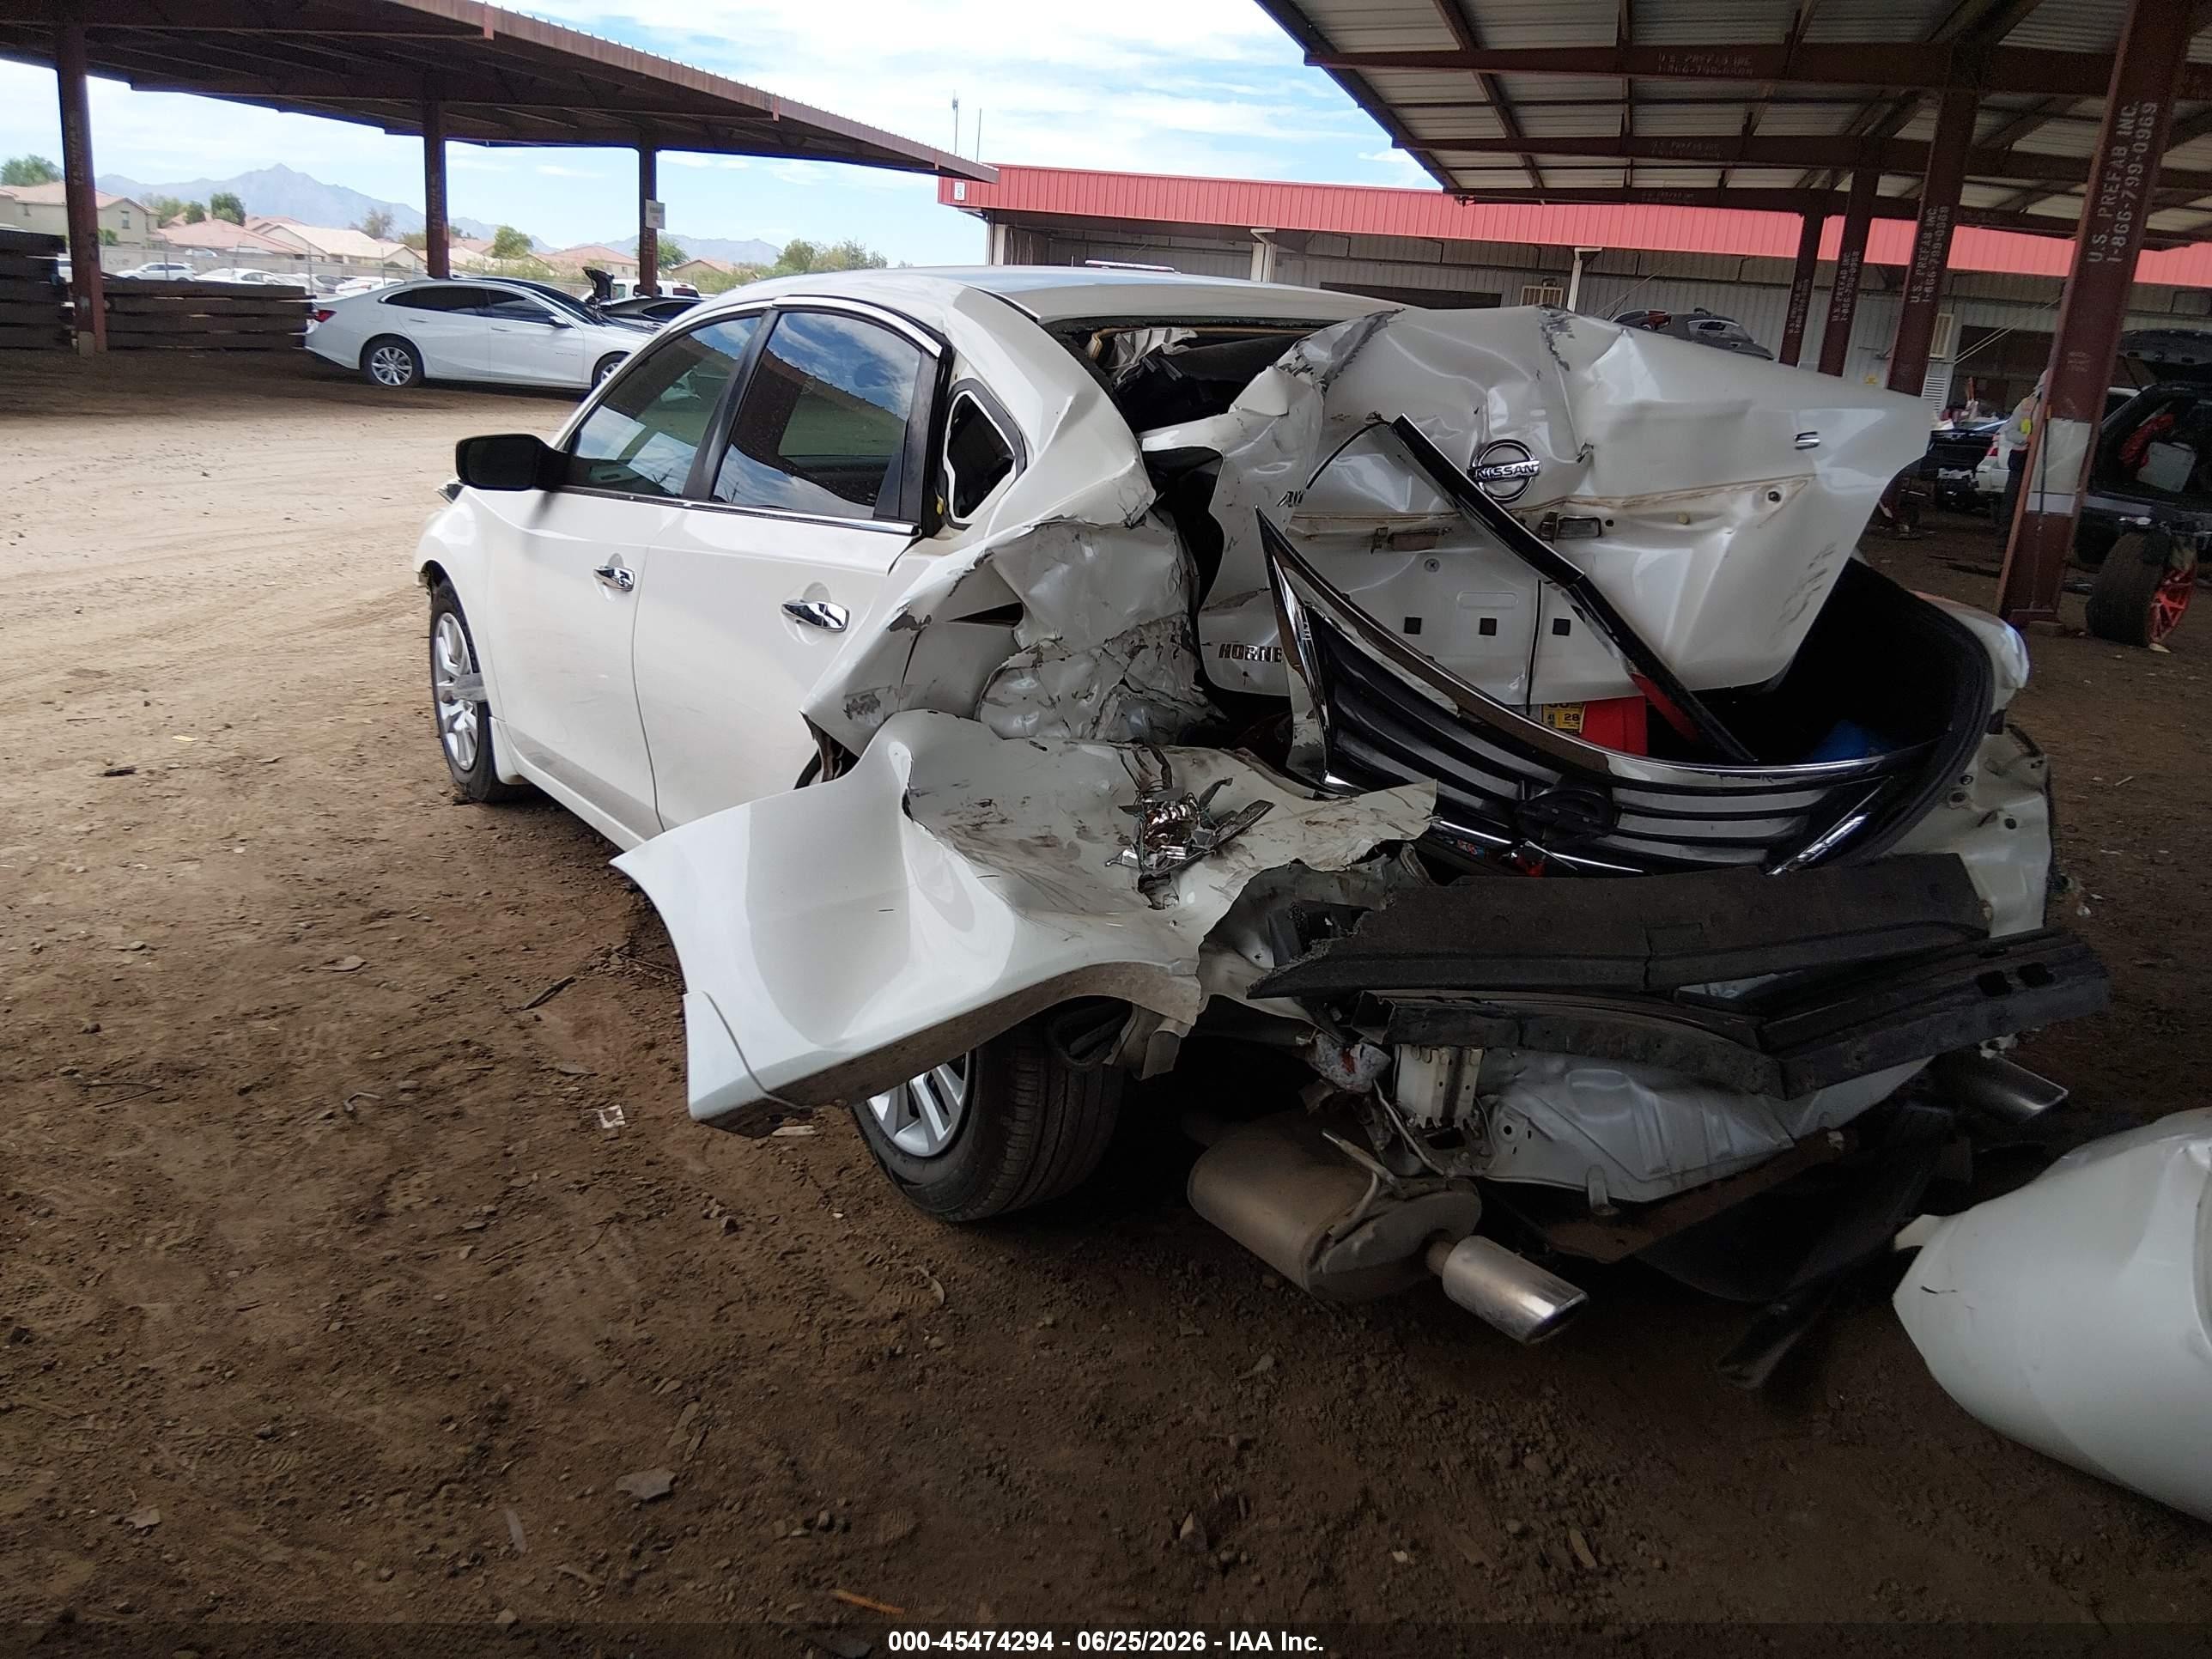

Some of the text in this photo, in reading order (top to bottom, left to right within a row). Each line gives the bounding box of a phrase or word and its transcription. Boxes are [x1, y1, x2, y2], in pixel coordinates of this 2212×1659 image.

[2087, 100, 2139, 263] U.S. PREFAB INC.
[2106, 101, 2158, 263] 1-866-799-0969
[1916, 232, 1933, 276] PREFAB
[1476, 465, 1535, 479] NISSAN
[1564, 713, 1580, 721] 28
